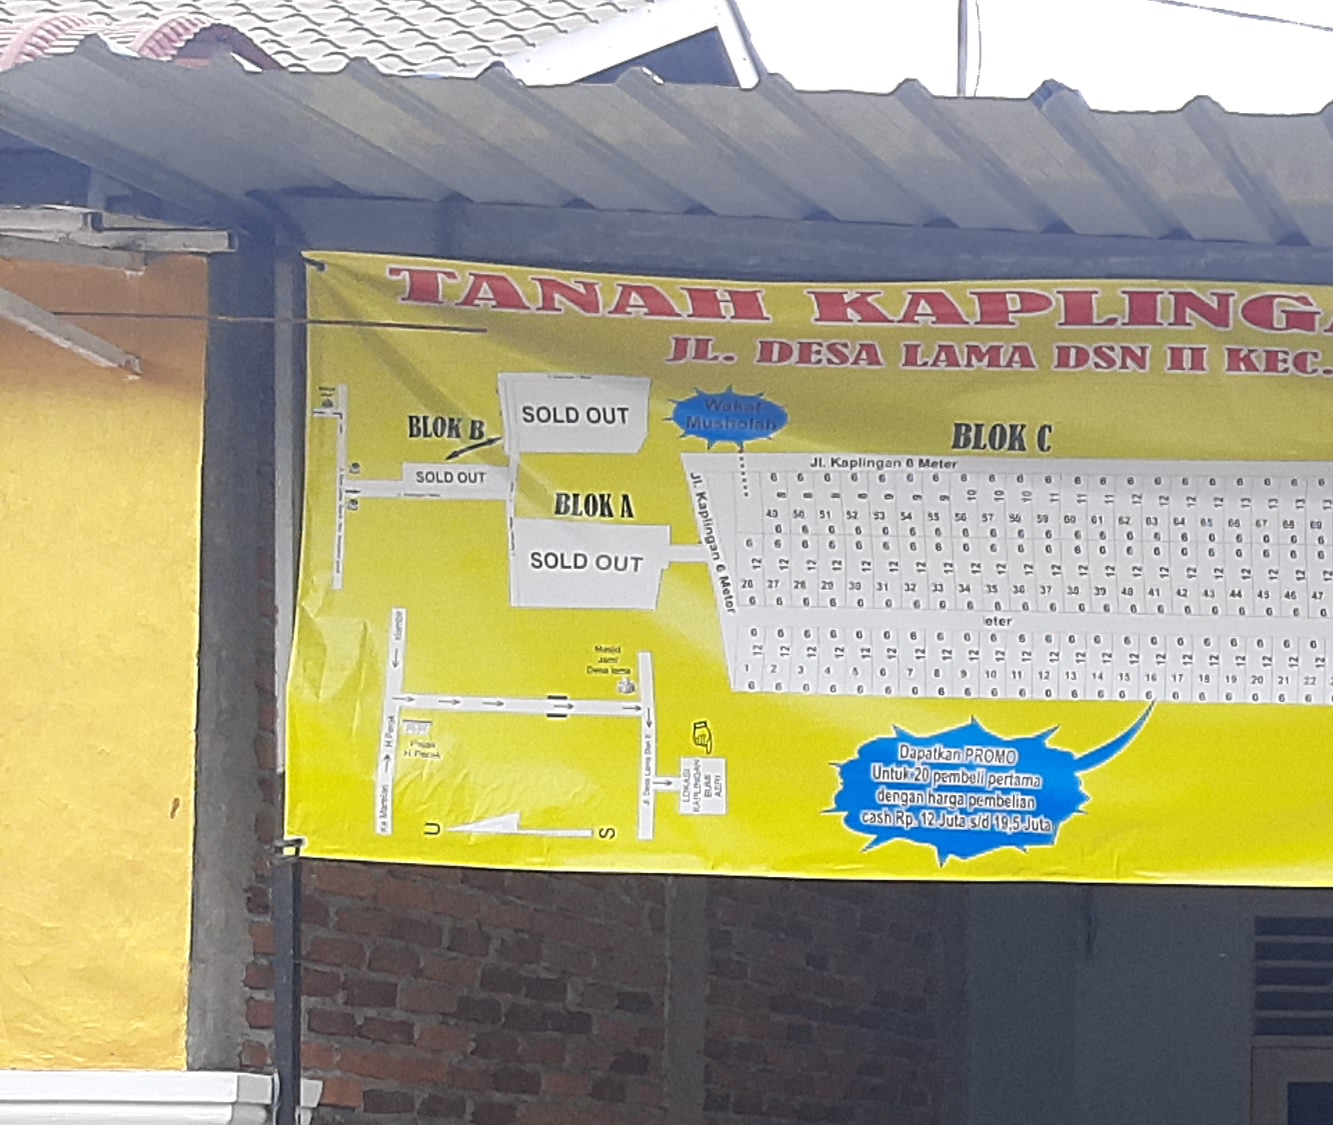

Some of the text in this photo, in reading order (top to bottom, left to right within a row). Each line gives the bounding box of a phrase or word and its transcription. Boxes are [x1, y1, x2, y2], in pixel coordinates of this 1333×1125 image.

[389, 266, 769, 322] TANAH
[666, 336, 735, 365] JL.
[756, 340, 883, 368] DESA
[901, 342, 1041, 370] LAMA
[1053, 345, 1149, 372] DSN
[1167, 346, 1207, 373] II
[1225, 347, 1333, 376] KEC.
[408, 415, 485, 440] BLOK B
[522, 407, 629, 426] SOLD OUT
[952, 422, 1052, 453] BLOK C
[416, 472, 486, 484] SOLD OUT
[555, 493, 634, 518] BLOK A
[530, 552, 644, 573] SOLD OUT
[899, 744, 1017, 764] Dapatkan PROMO
[872, 765, 1040, 789] Untuk 20 pembeli pertama
[877, 788, 1036, 810] dengan harga pembelian
[862, 810, 892, 825] cash
[921, 812, 935, 827] 12
[939, 812, 966, 828] Juta
[971, 813, 990, 830] s/d
[994, 815, 1020, 832] 19,5
[1024, 817, 1052, 833] Juta
